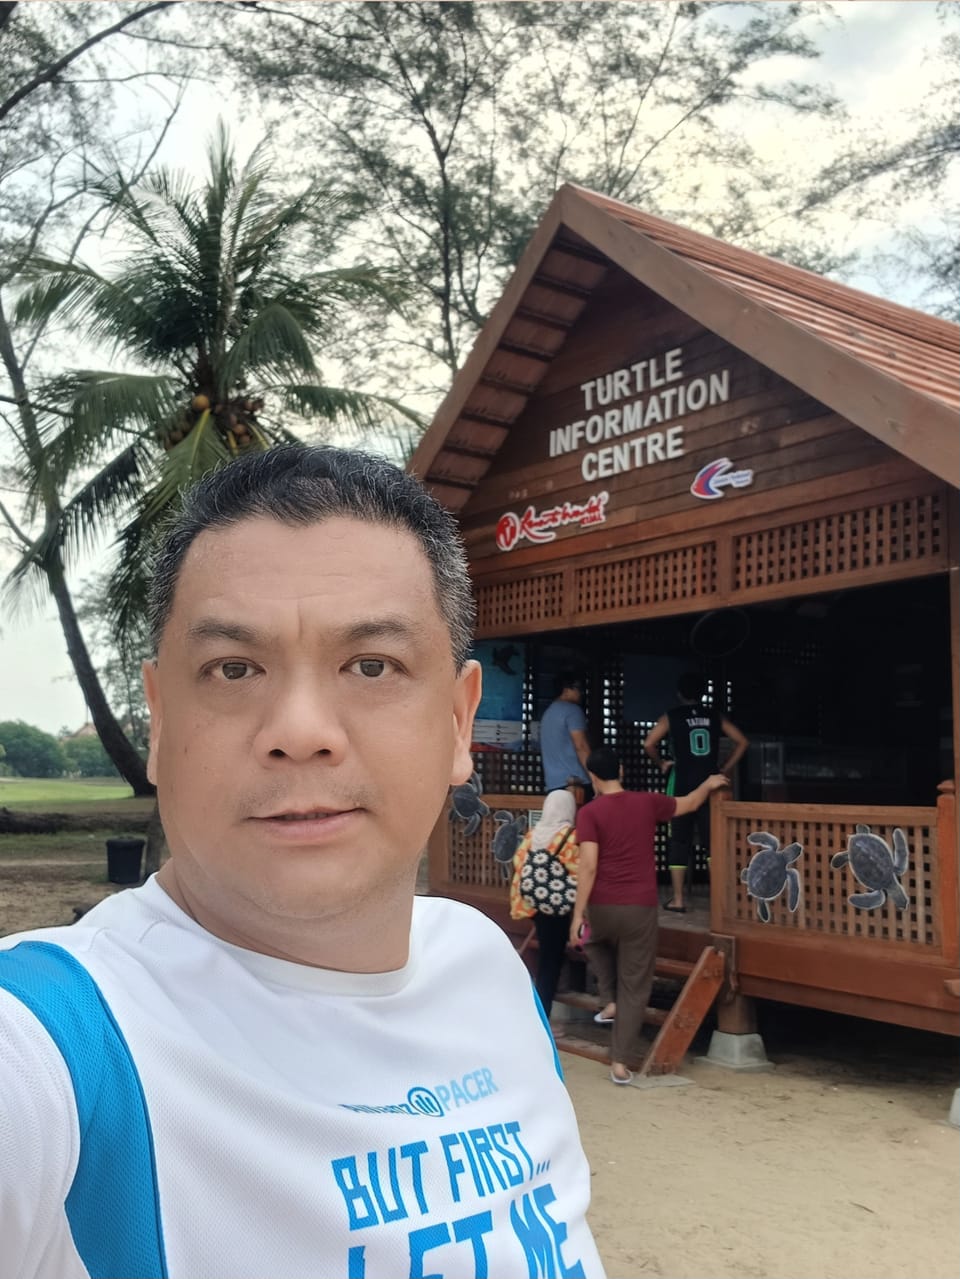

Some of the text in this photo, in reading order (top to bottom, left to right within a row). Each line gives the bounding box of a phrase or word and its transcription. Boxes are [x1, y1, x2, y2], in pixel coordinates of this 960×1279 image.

[580, 347, 684, 411] TURTLE
[549, 369, 731, 458] INFORMATION
[580, 424, 685, 482] CENTRE
[434, 1067, 499, 1112] PACER
[331, 1140, 429, 1232] BUT
